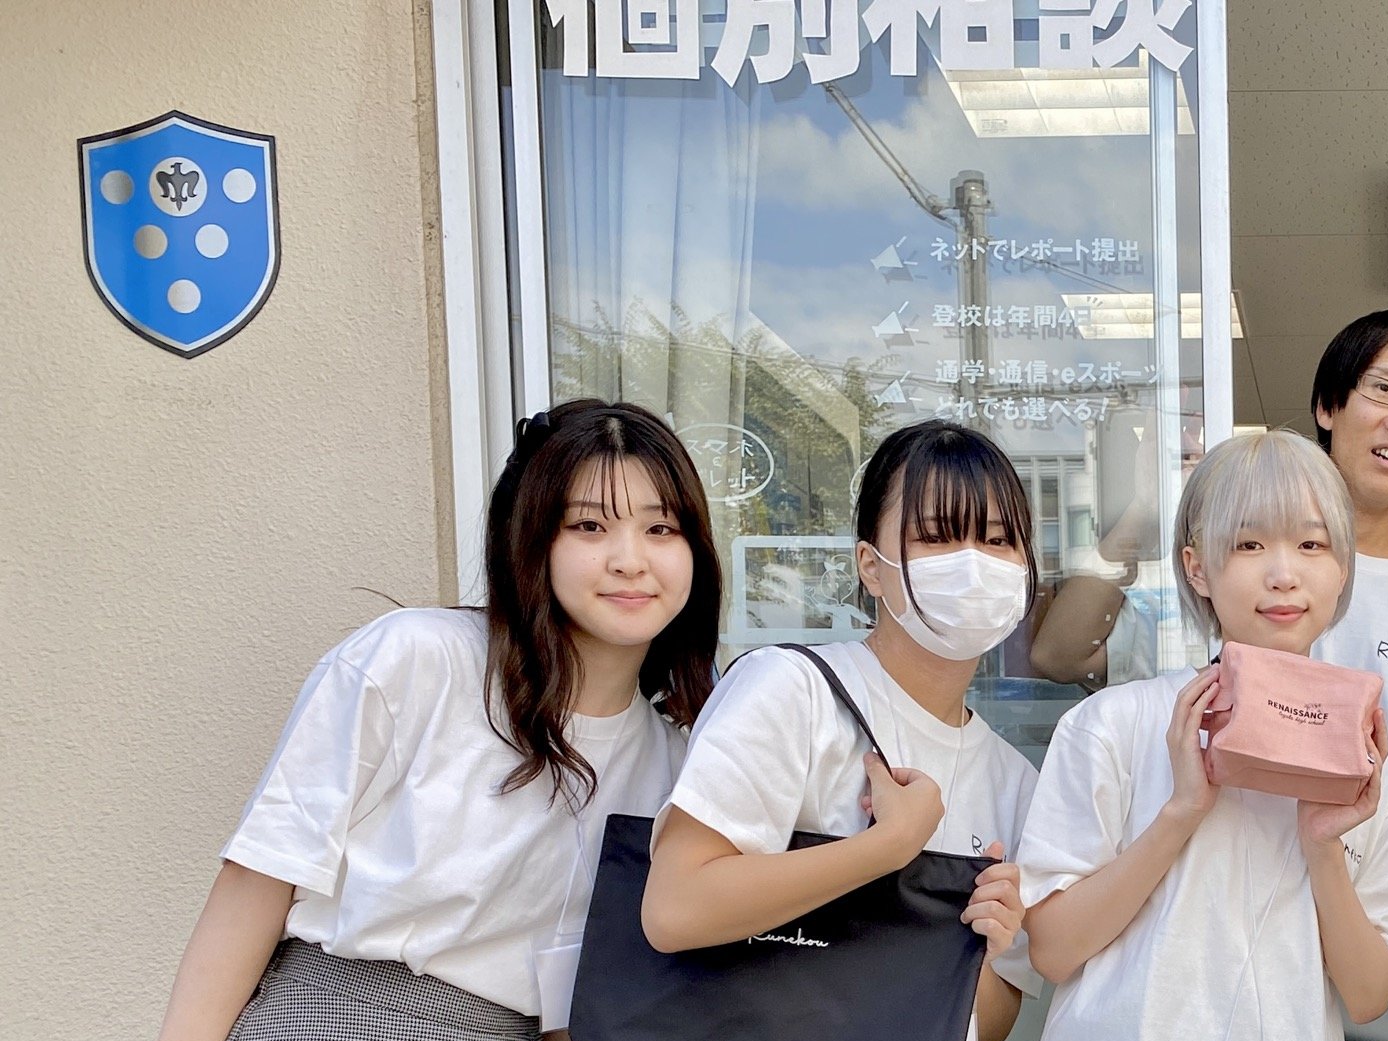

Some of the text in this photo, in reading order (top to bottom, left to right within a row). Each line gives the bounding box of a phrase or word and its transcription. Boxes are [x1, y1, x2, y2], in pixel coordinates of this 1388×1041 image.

[929, 237, 1139, 263] ネットでレポート提出
[1267, 699, 1329, 720] RENAISSANCE
